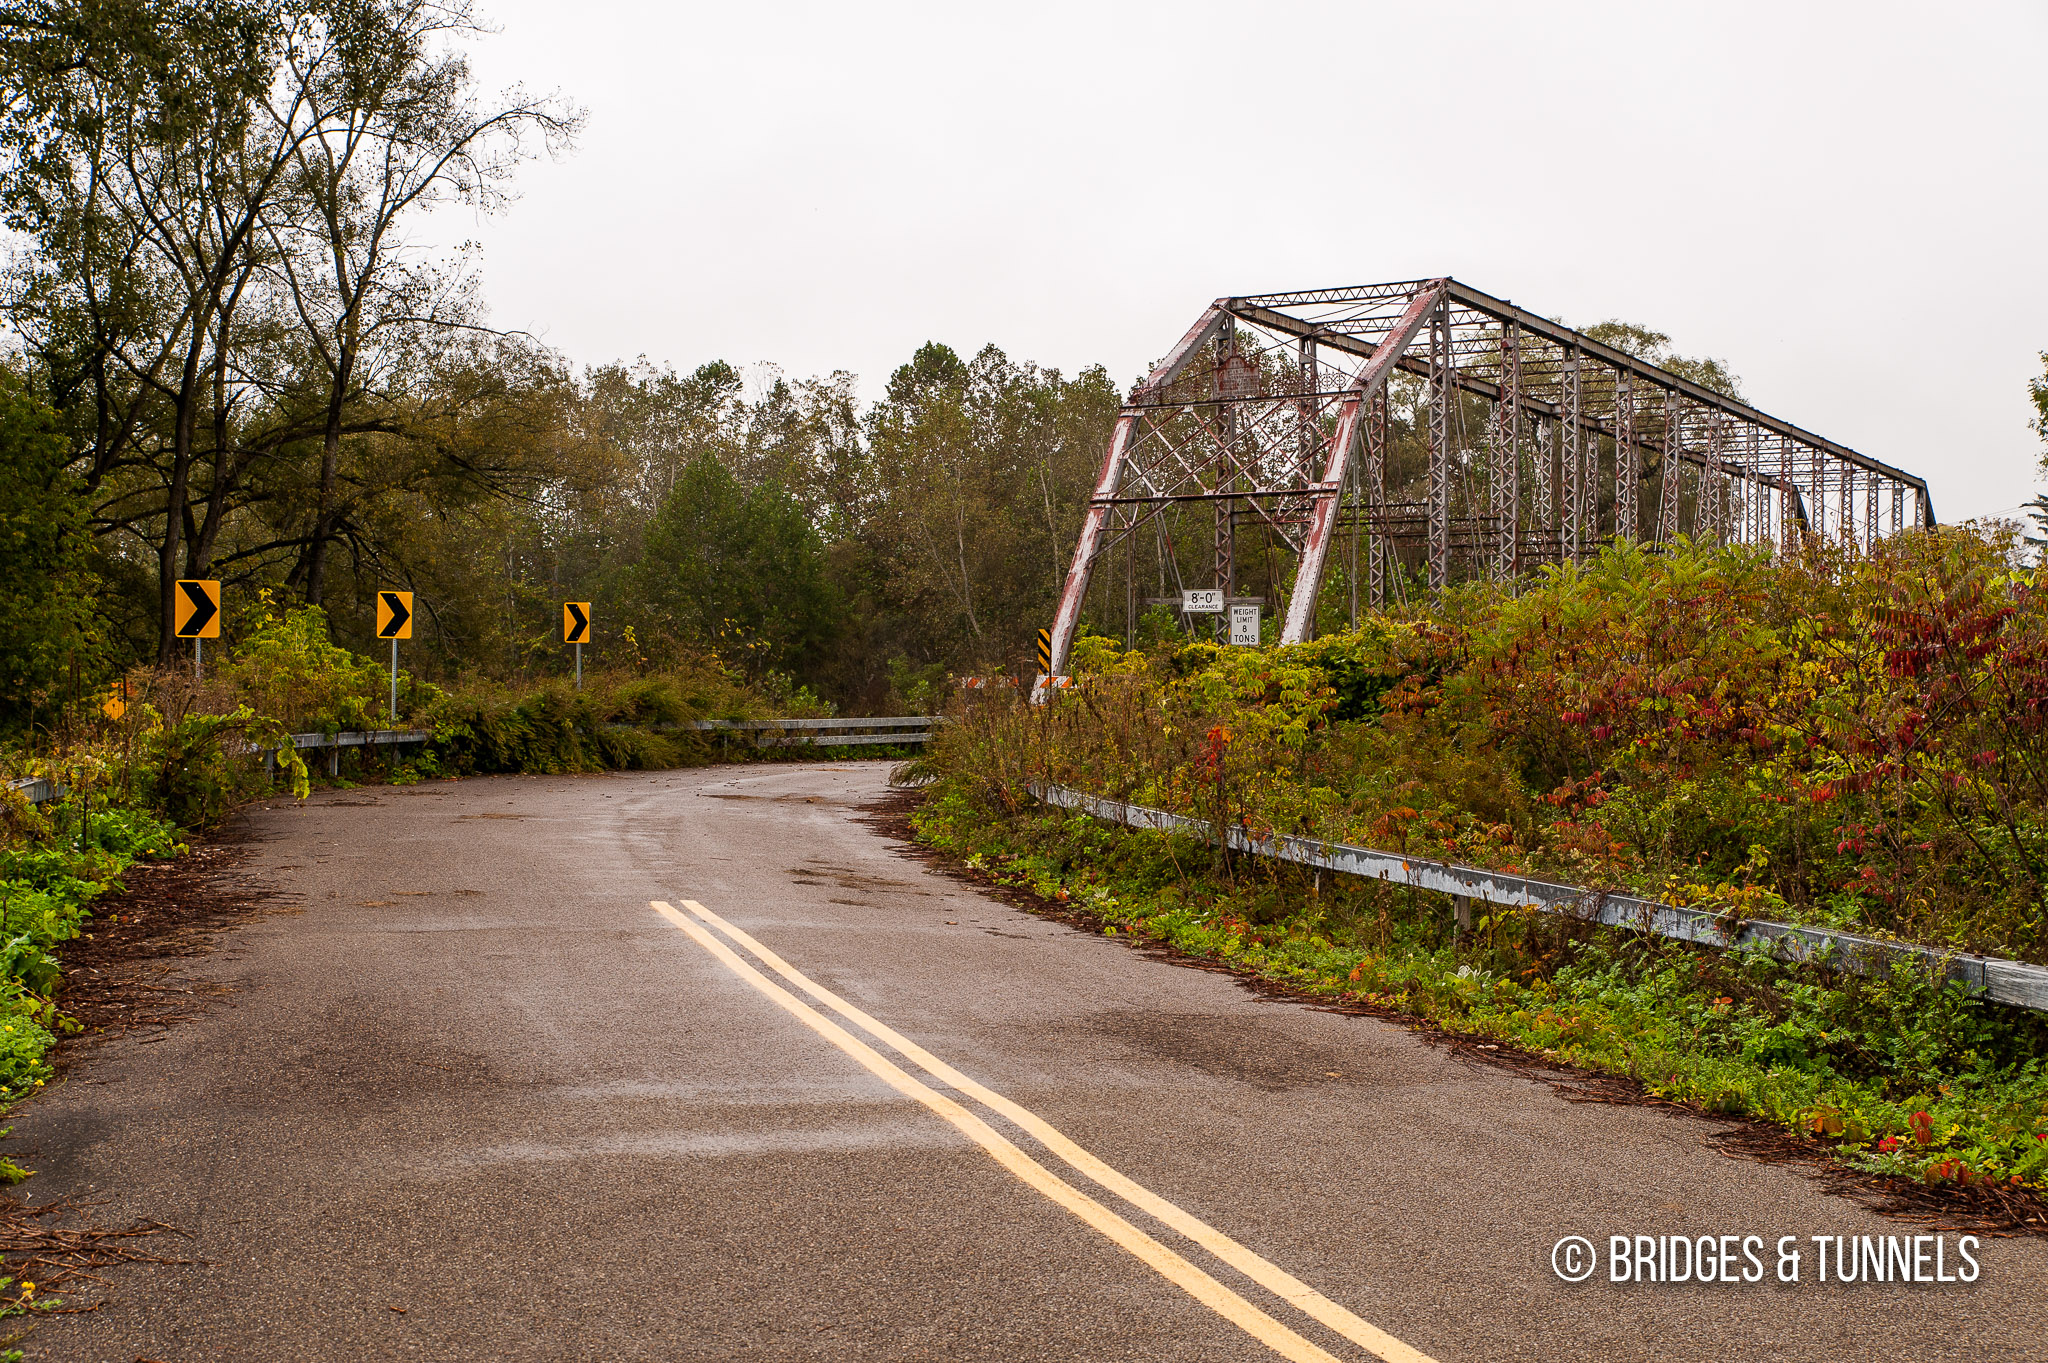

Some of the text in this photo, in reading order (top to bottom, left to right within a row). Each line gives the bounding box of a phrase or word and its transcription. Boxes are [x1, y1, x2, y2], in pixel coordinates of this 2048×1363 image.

[1233, 608, 1257, 616] WEIGHT
[1242, 625, 1247, 633] 8
[1234, 634, 1256, 643] TONS
